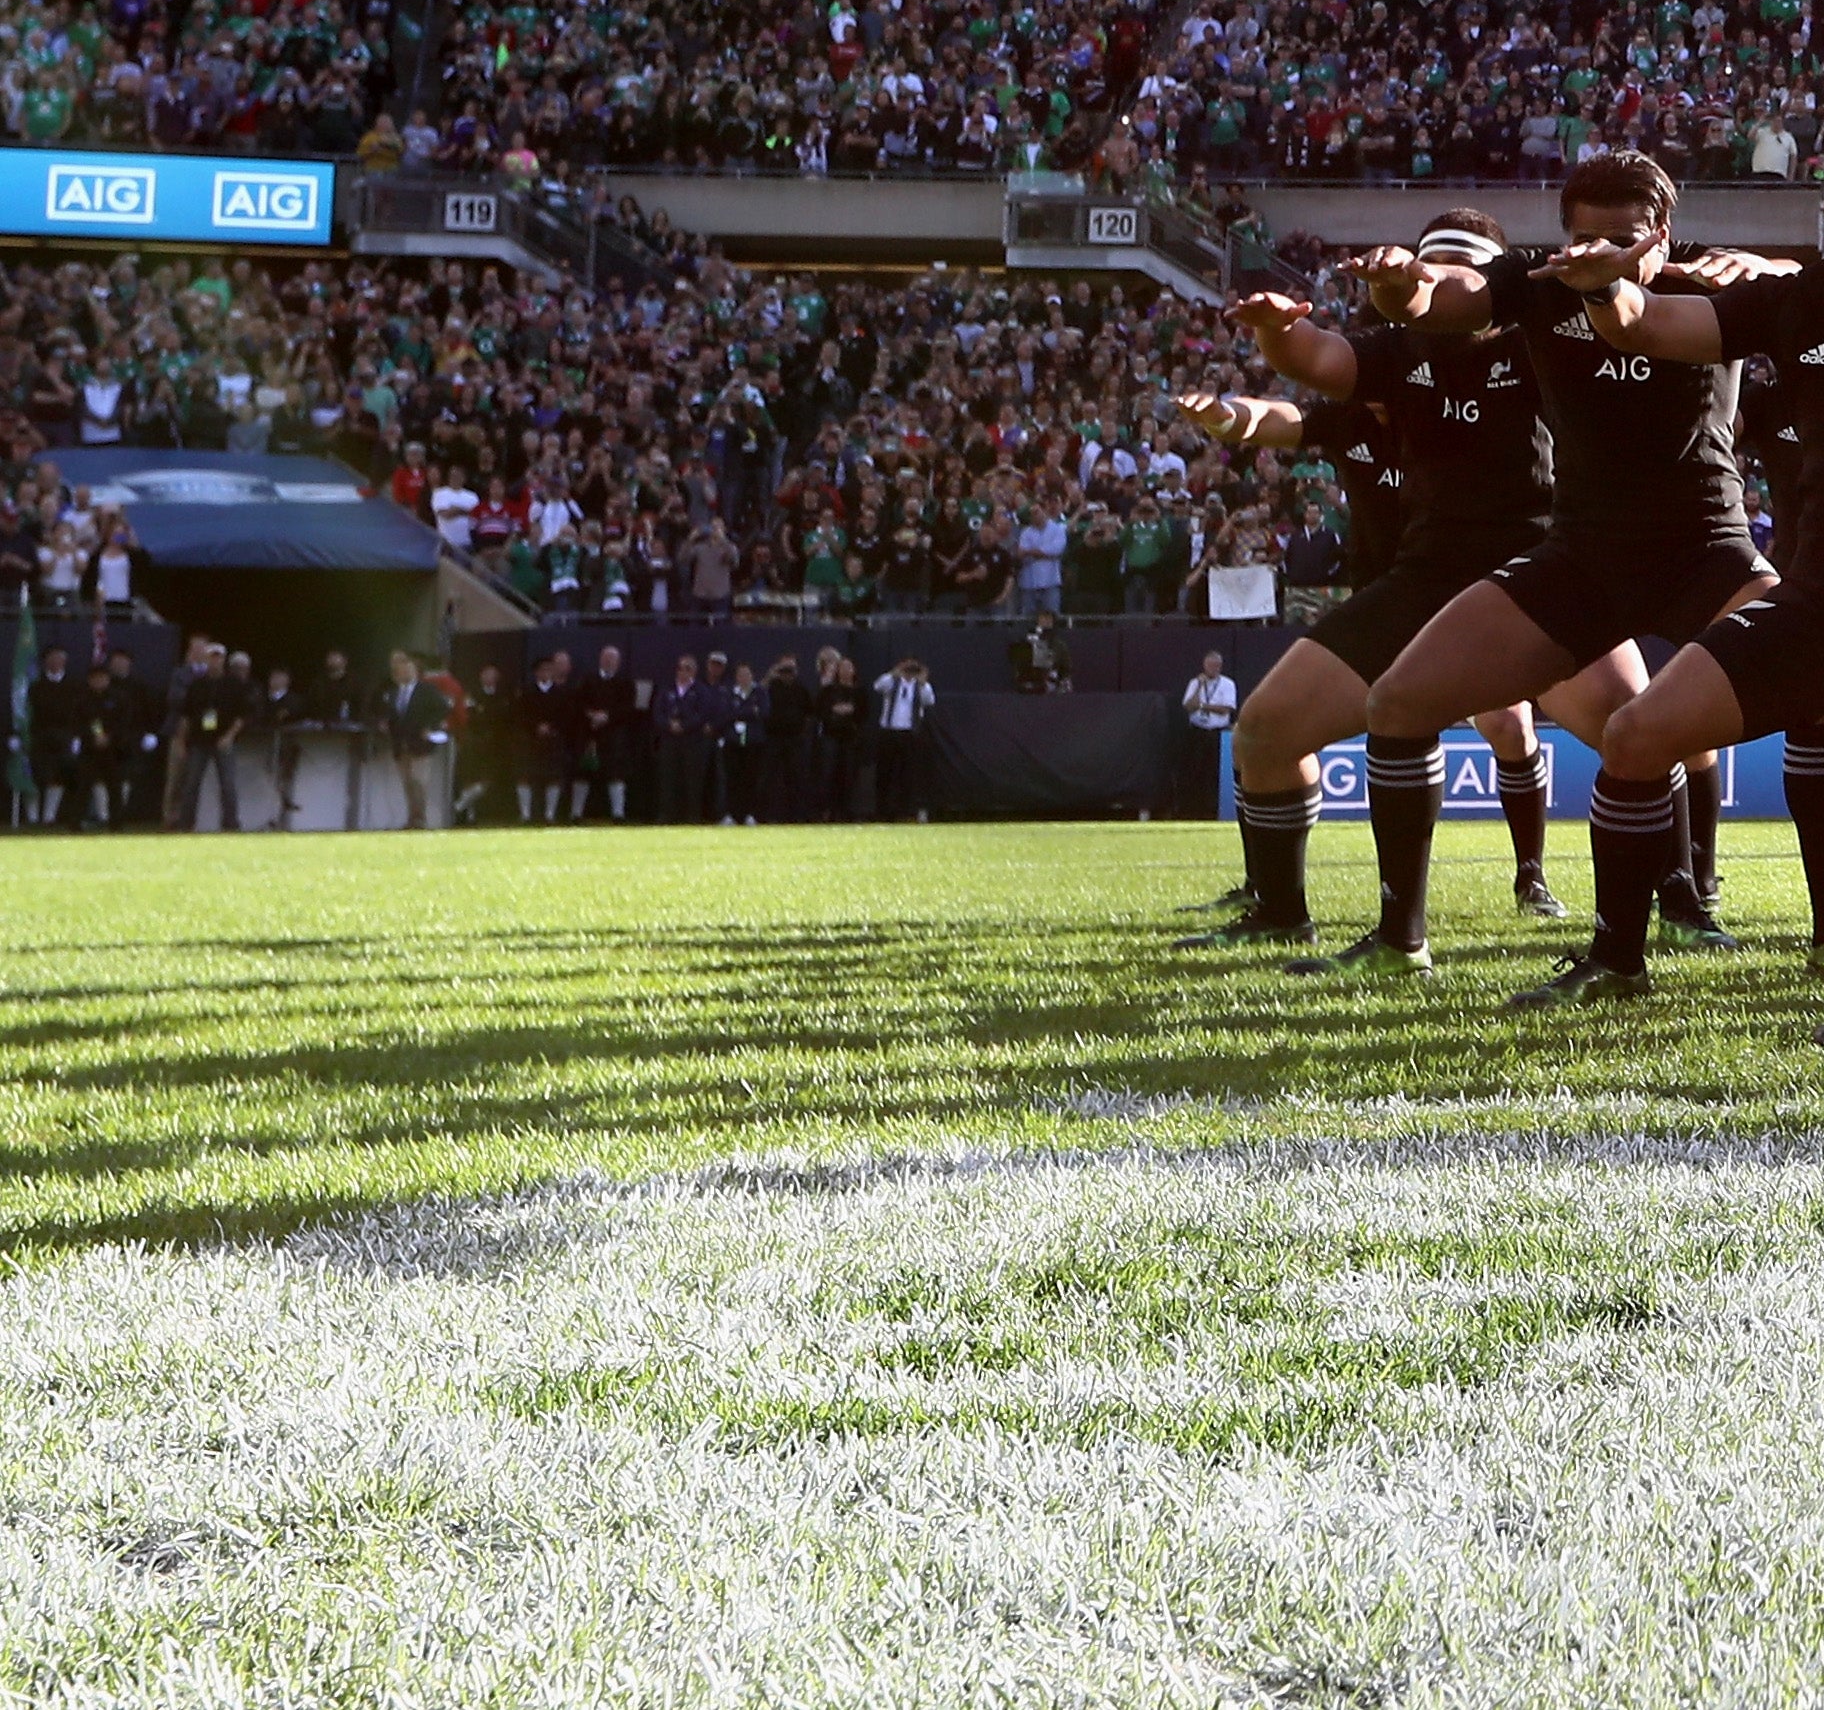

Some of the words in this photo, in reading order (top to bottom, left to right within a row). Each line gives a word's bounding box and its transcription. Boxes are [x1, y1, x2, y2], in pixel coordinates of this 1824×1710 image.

[58, 175, 142, 213] AIG
[223, 182, 304, 220] AIG
[450, 198, 491, 224] 119
[1093, 211, 1133, 238] 120
[1553, 325, 1594, 340] adidas
[1594, 356, 1651, 381] AIG
[1442, 396, 1479, 423] AIG
[1377, 468, 1404, 487] AI
[1451, 757, 1497, 795] AI
